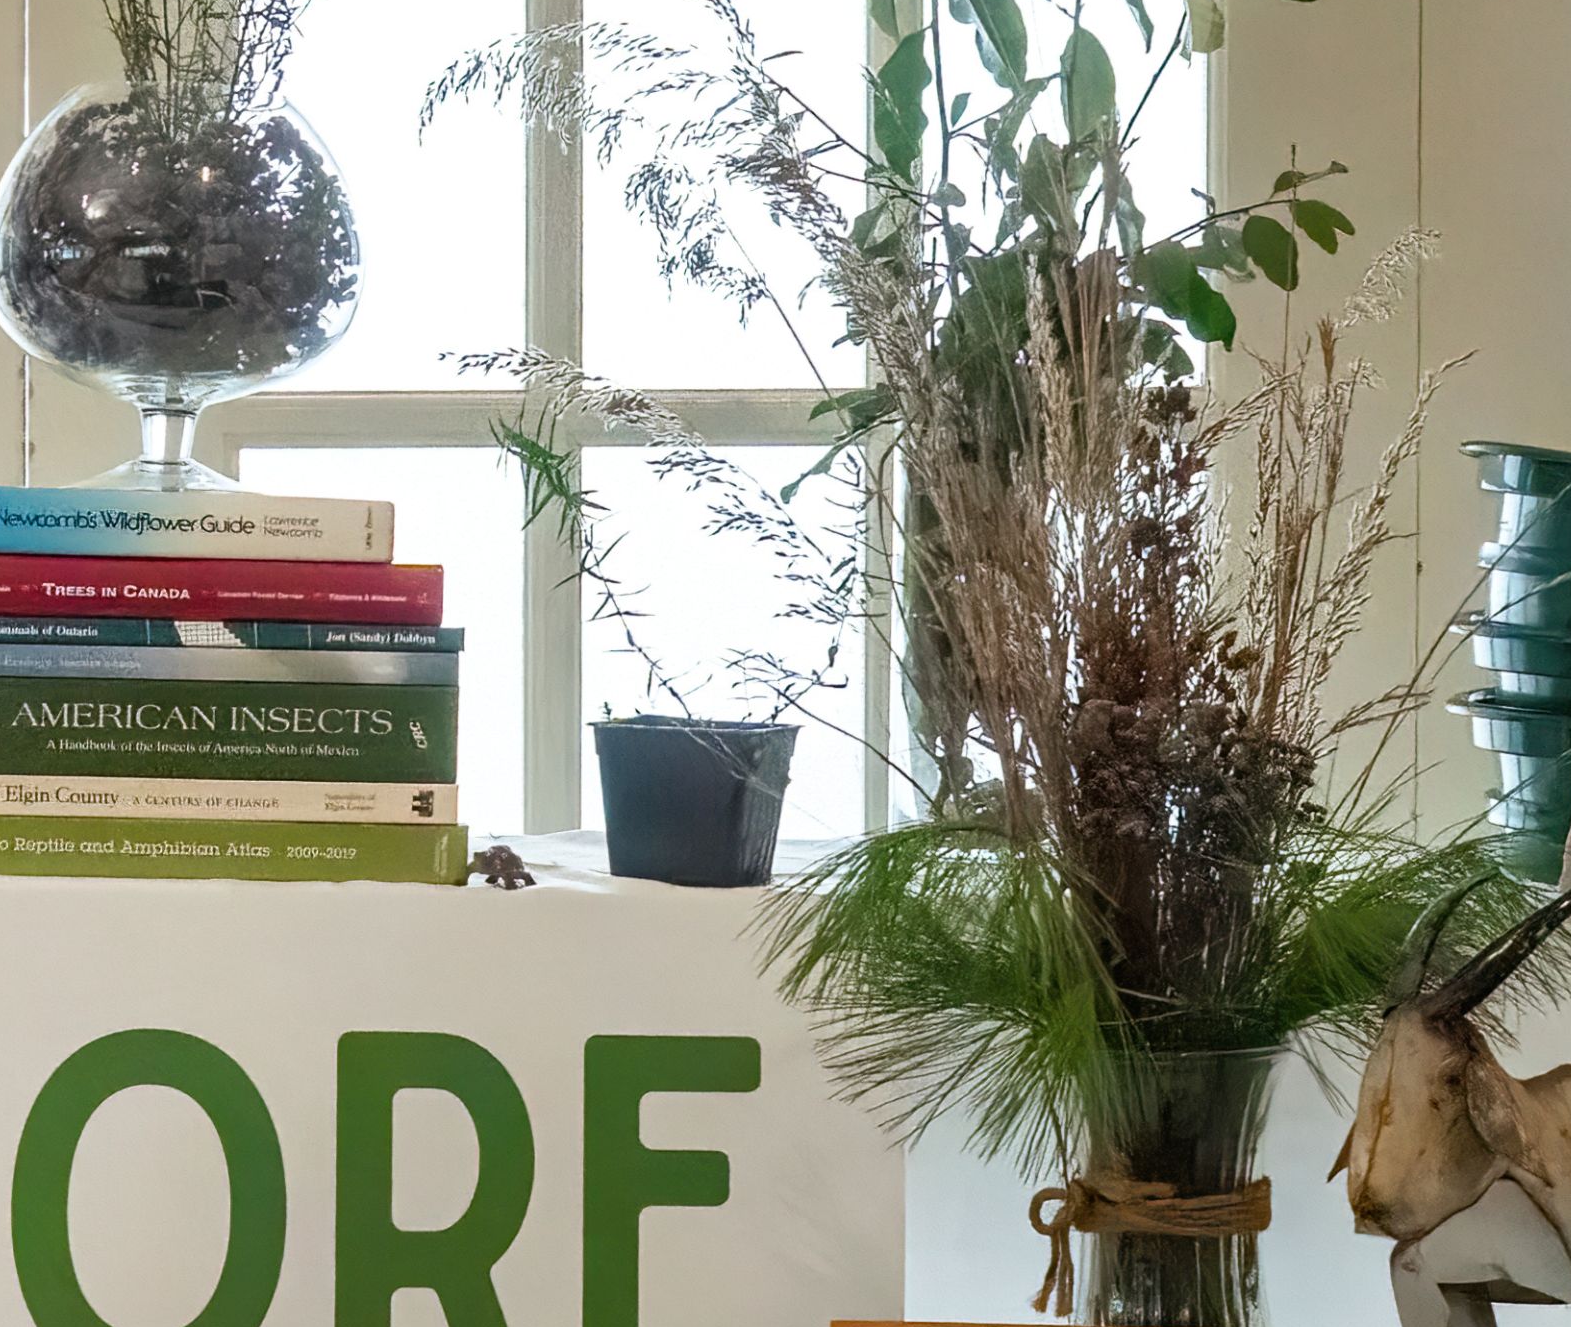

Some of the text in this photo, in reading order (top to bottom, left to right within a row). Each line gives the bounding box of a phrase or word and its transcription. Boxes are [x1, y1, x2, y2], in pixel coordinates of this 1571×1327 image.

[99, 510, 197, 535] Wildflower
[200, 514, 255, 534] Guide
[42, 582, 190, 600] TREES IN CANADA
[42, 624, 54, 636] of
[56, 625, 98, 637] Ontario
[326, 631, 346, 642] Jon
[349, 631, 390, 645] (Sandy)
[11, 702, 393, 735] AMERICAN INSECTS
[46, 738, 360, 757] A Handbook of the Insects of America North of Mexico
[5, 785, 50, 805] Elgin
[56, 787, 119, 808] County
[132, 794, 280, 809] A CENTURY OF CHANGE
[14, 837, 75, 855] Reptile
[79, 839, 115, 853] and
[120, 840, 221, 859] Amphibian
[225, 841, 270, 858] Atlas
